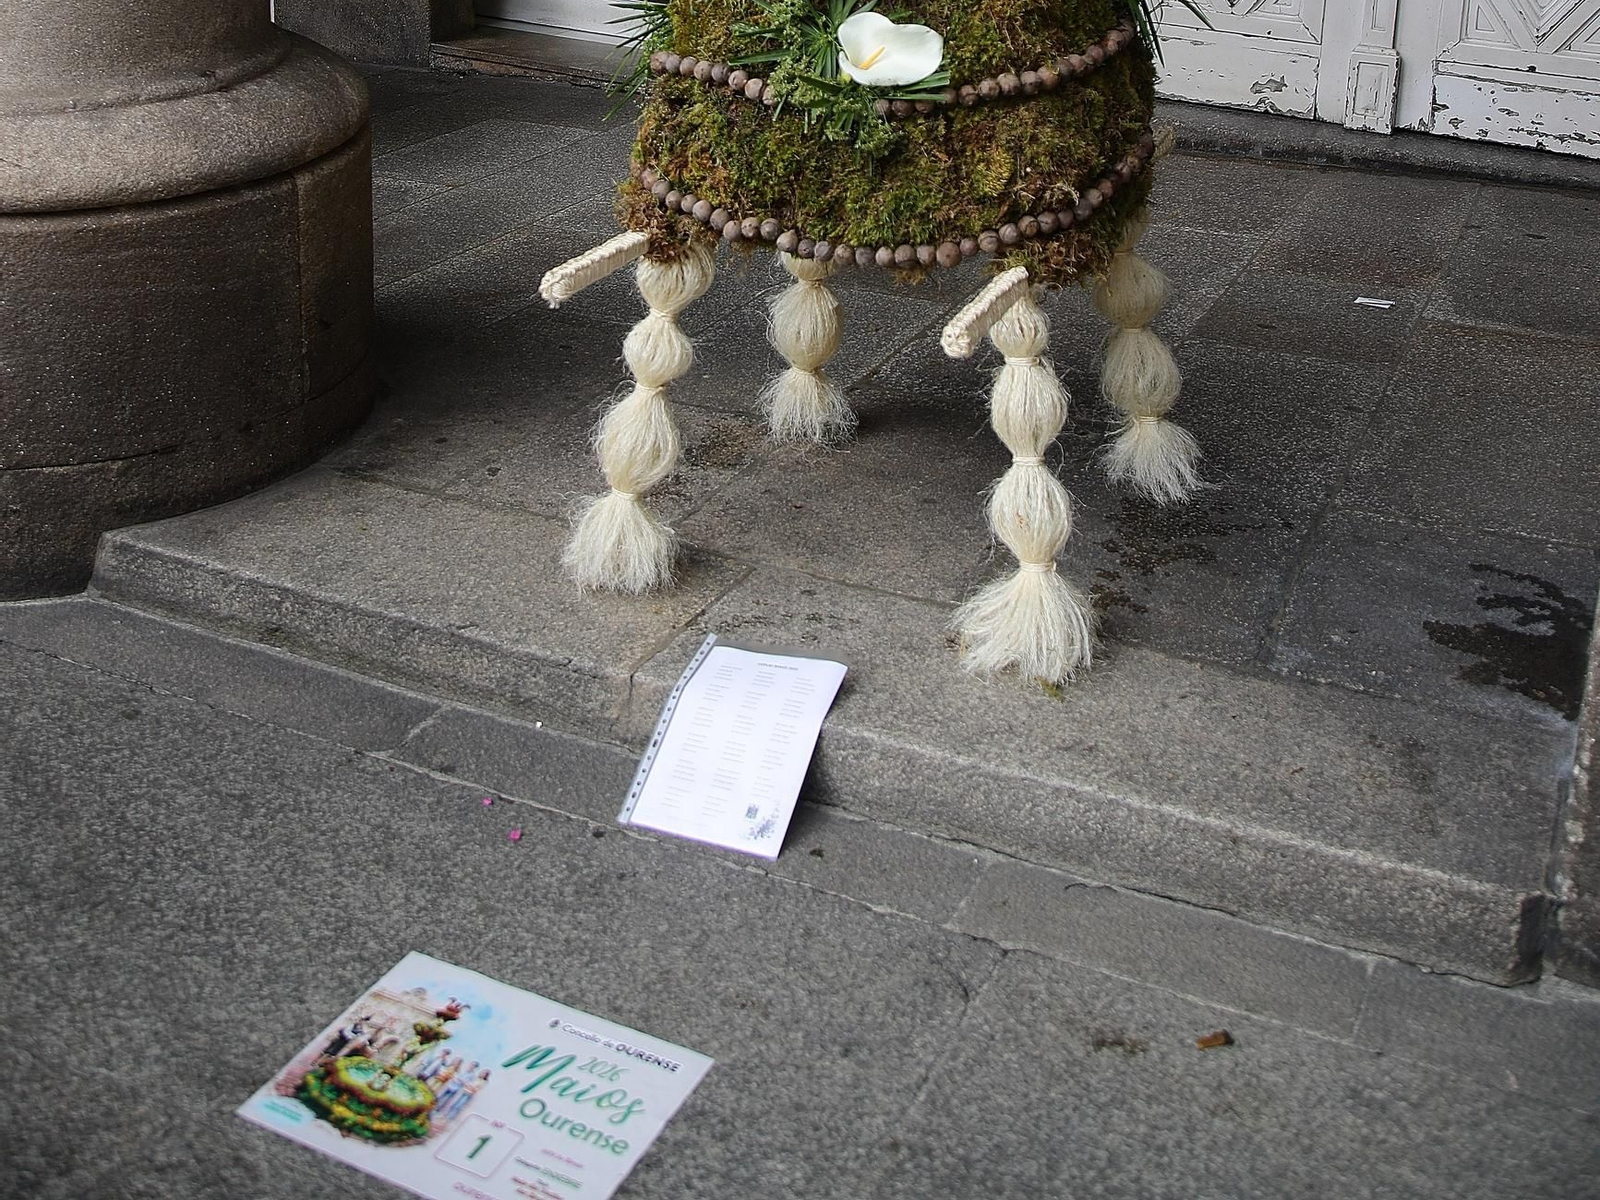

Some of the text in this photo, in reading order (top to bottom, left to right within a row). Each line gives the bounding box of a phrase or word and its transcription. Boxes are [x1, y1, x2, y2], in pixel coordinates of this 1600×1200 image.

[616, 1043, 681, 1072] OURENSE
[501, 1044, 646, 1124] Maios
[467, 1134, 492, 1159] 1
[519, 1098, 630, 1155] Ourense
